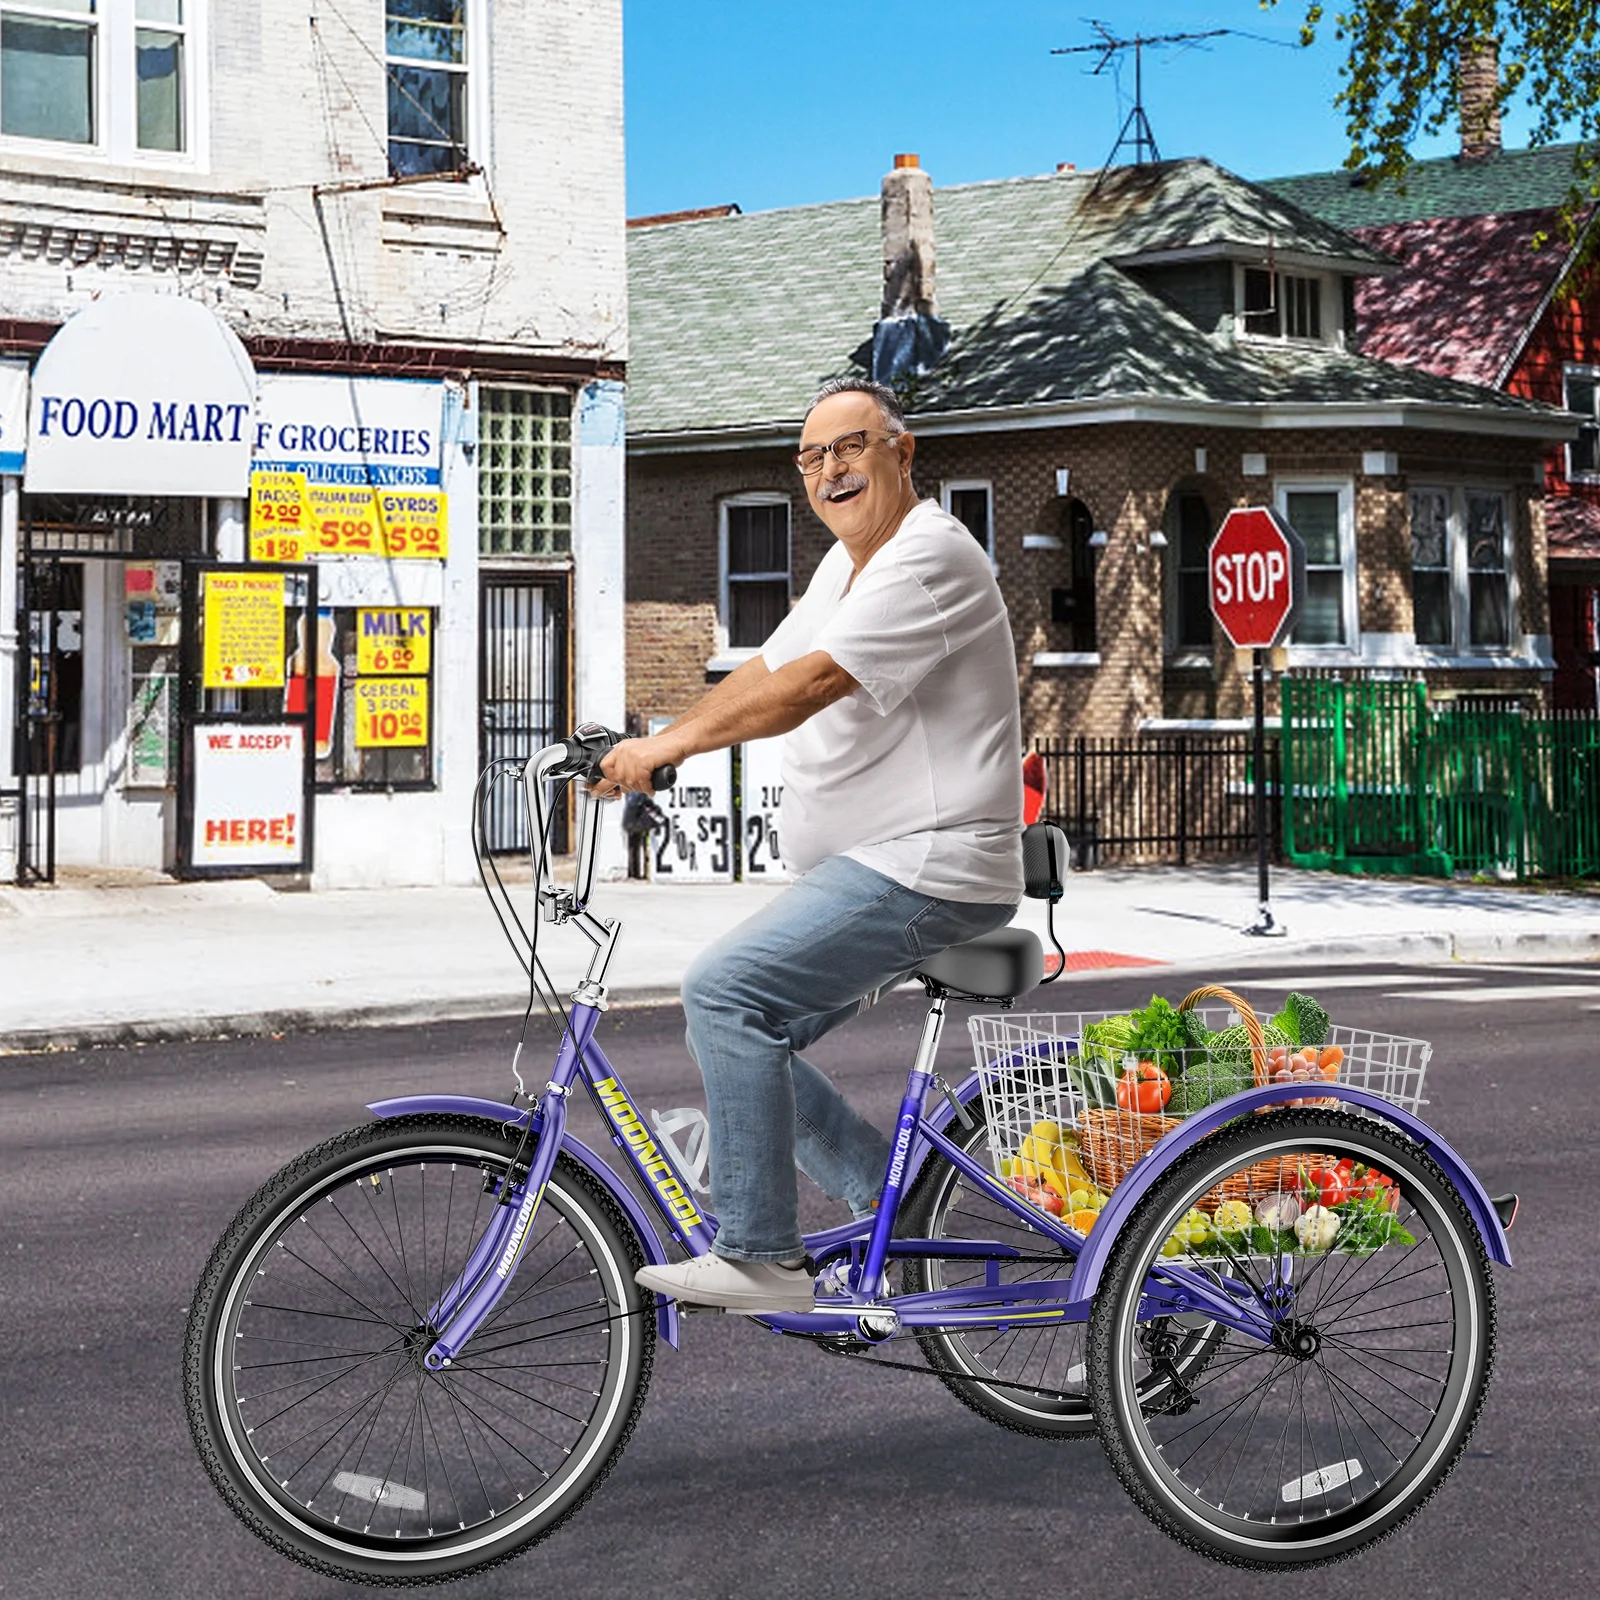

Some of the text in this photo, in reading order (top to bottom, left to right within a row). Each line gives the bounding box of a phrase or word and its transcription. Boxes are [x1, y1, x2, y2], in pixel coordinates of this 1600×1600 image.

[39, 396, 139, 439] FOOD
[147, 401, 250, 442] MART
[278, 423, 431, 457] GROCERIES
[382, 496, 439, 514] GYROS
[1214, 550, 1285, 605] STOP
[363, 611, 427, 637] MILK
[359, 683, 420, 698] CEREAL
[367, 699, 410, 713] 3 FOR
[207, 734, 292, 751] WE ACCEPT
[668, 786, 712, 808] 2 LITER
[762, 786, 768, 808] 2
[205, 813, 296, 846] HERE!
[746, 815, 765, 873] 2
[593, 1076, 703, 1237] MOONCOOL
[887, 1127, 912, 1188] MOONCOOL
[495, 1191, 538, 1280] MOONCOOL
